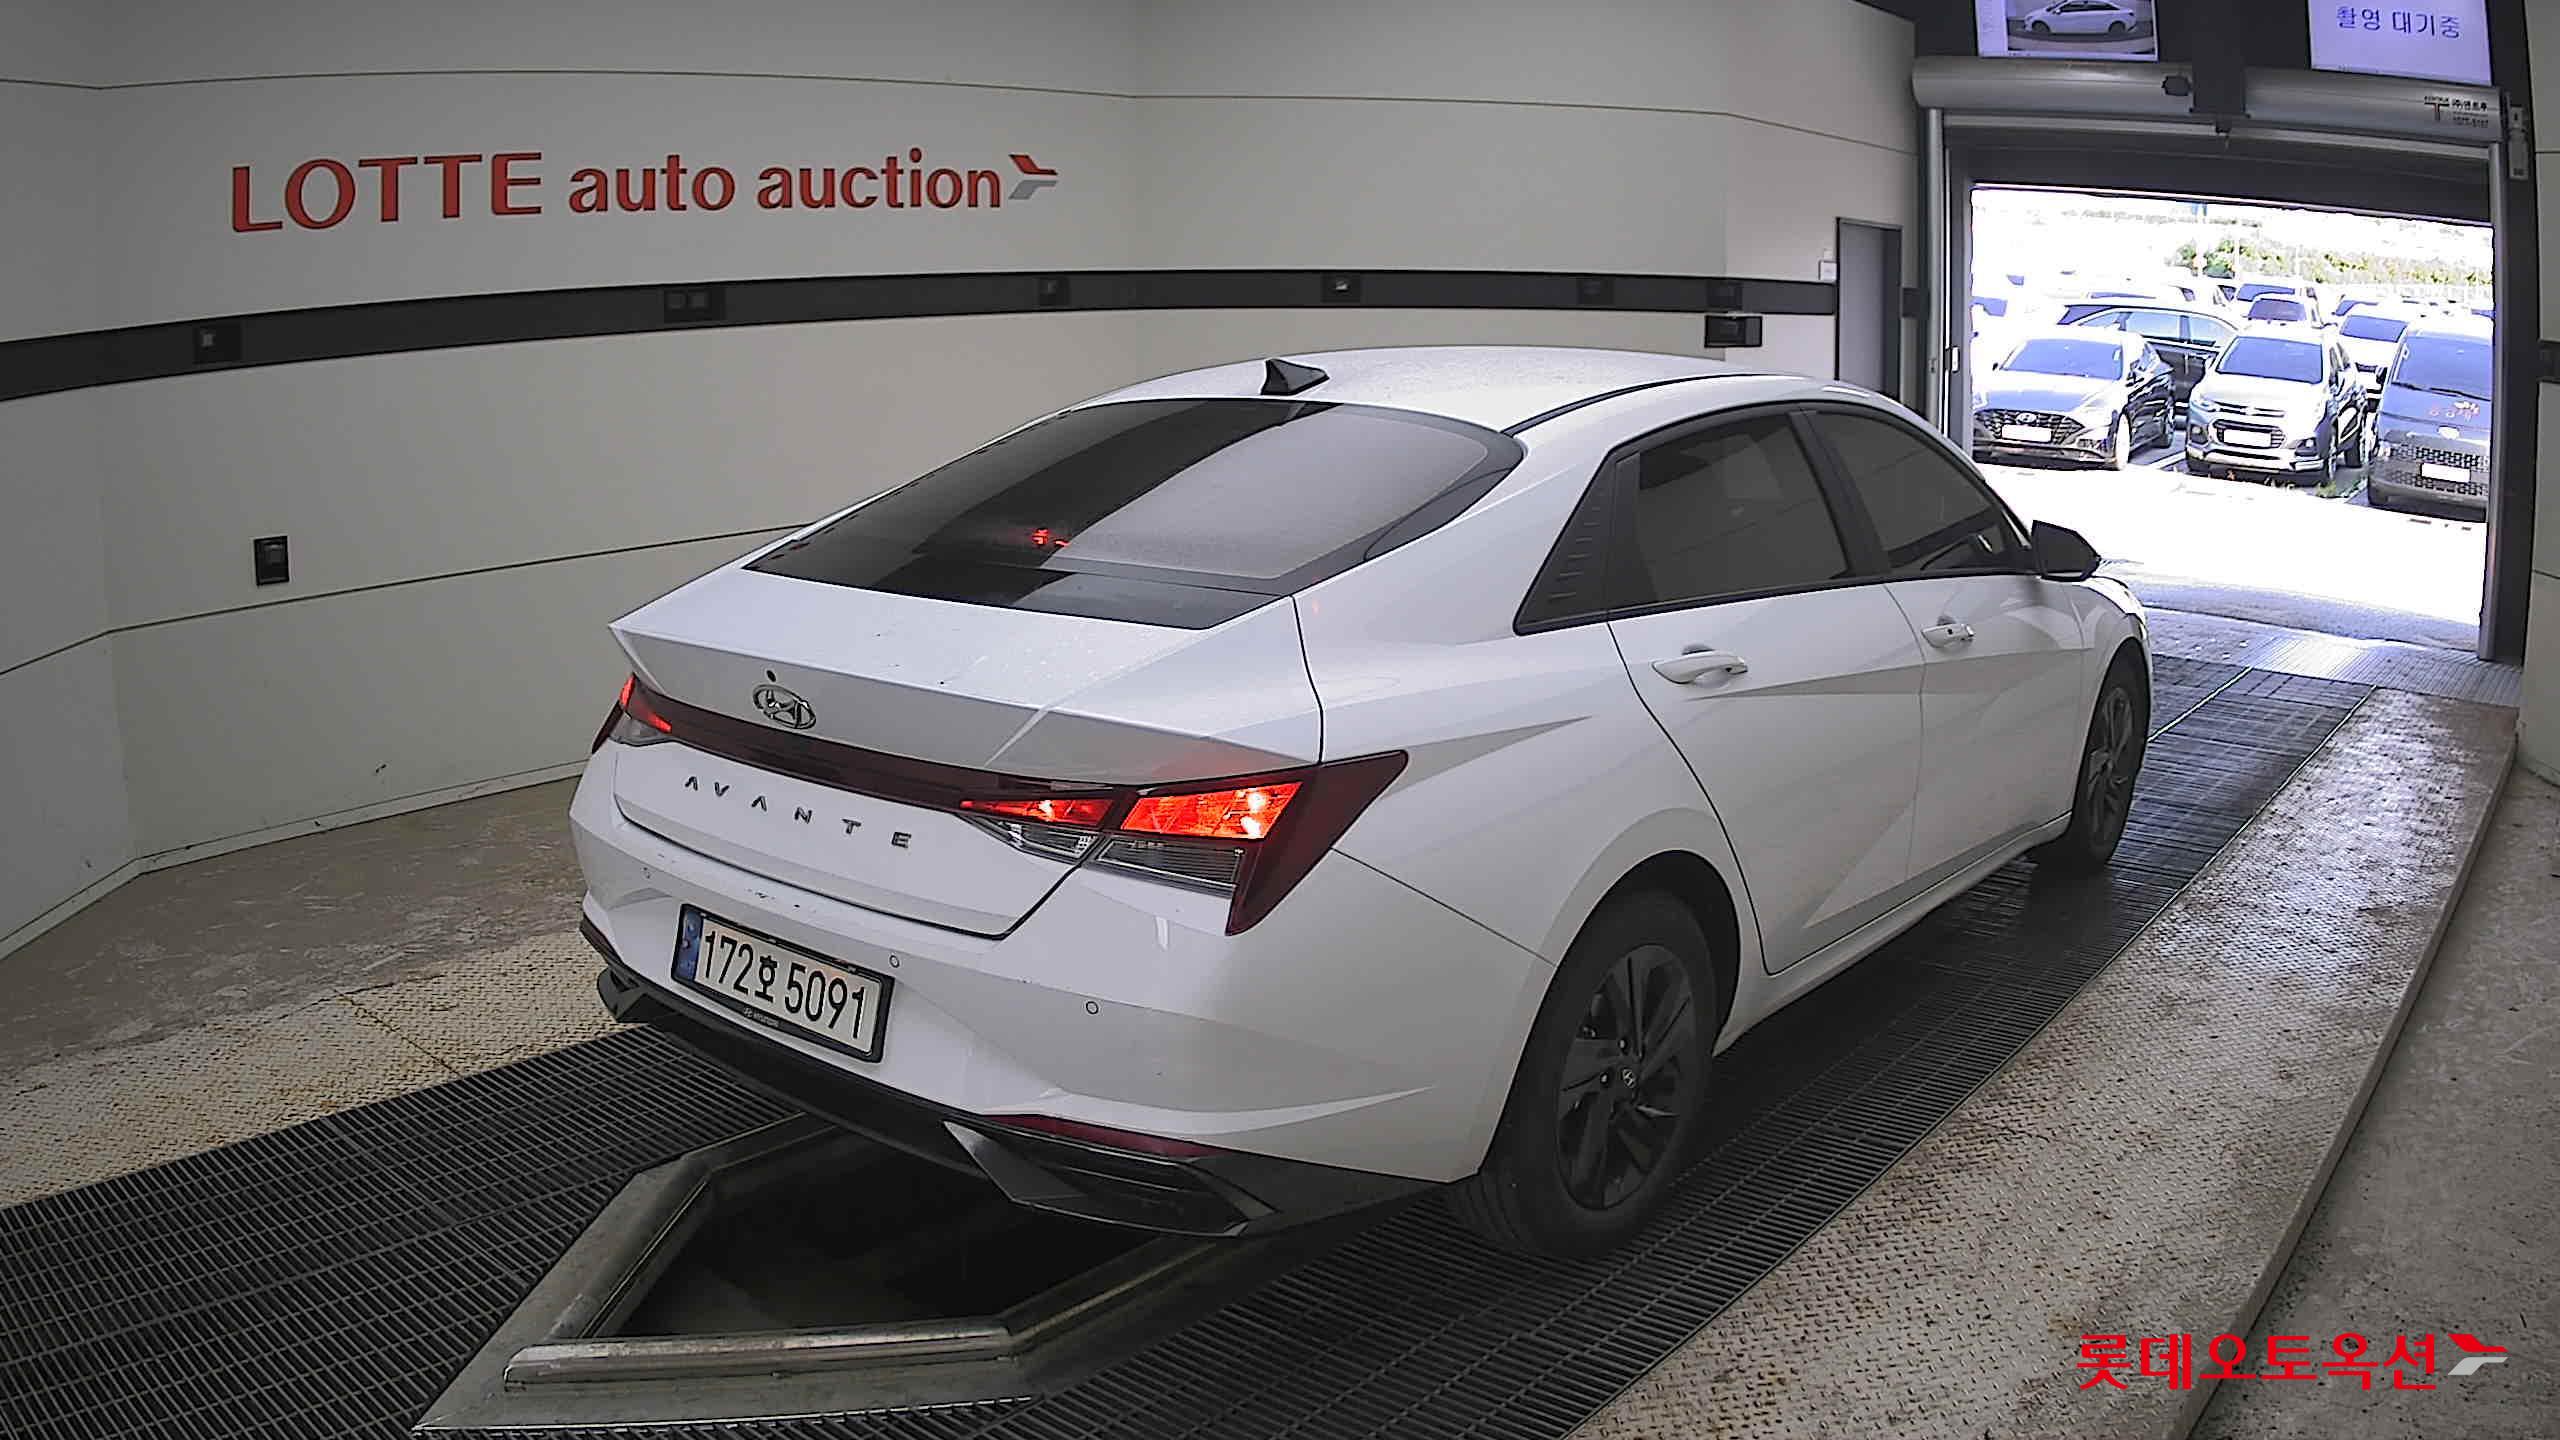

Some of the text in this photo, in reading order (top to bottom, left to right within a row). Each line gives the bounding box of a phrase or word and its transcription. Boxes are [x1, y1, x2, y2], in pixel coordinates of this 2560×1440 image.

[2392, 11, 2460, 39] 대기중
[231, 147, 1001, 232] LOTTE auto auction
[684, 775, 912, 849] AVANTE
